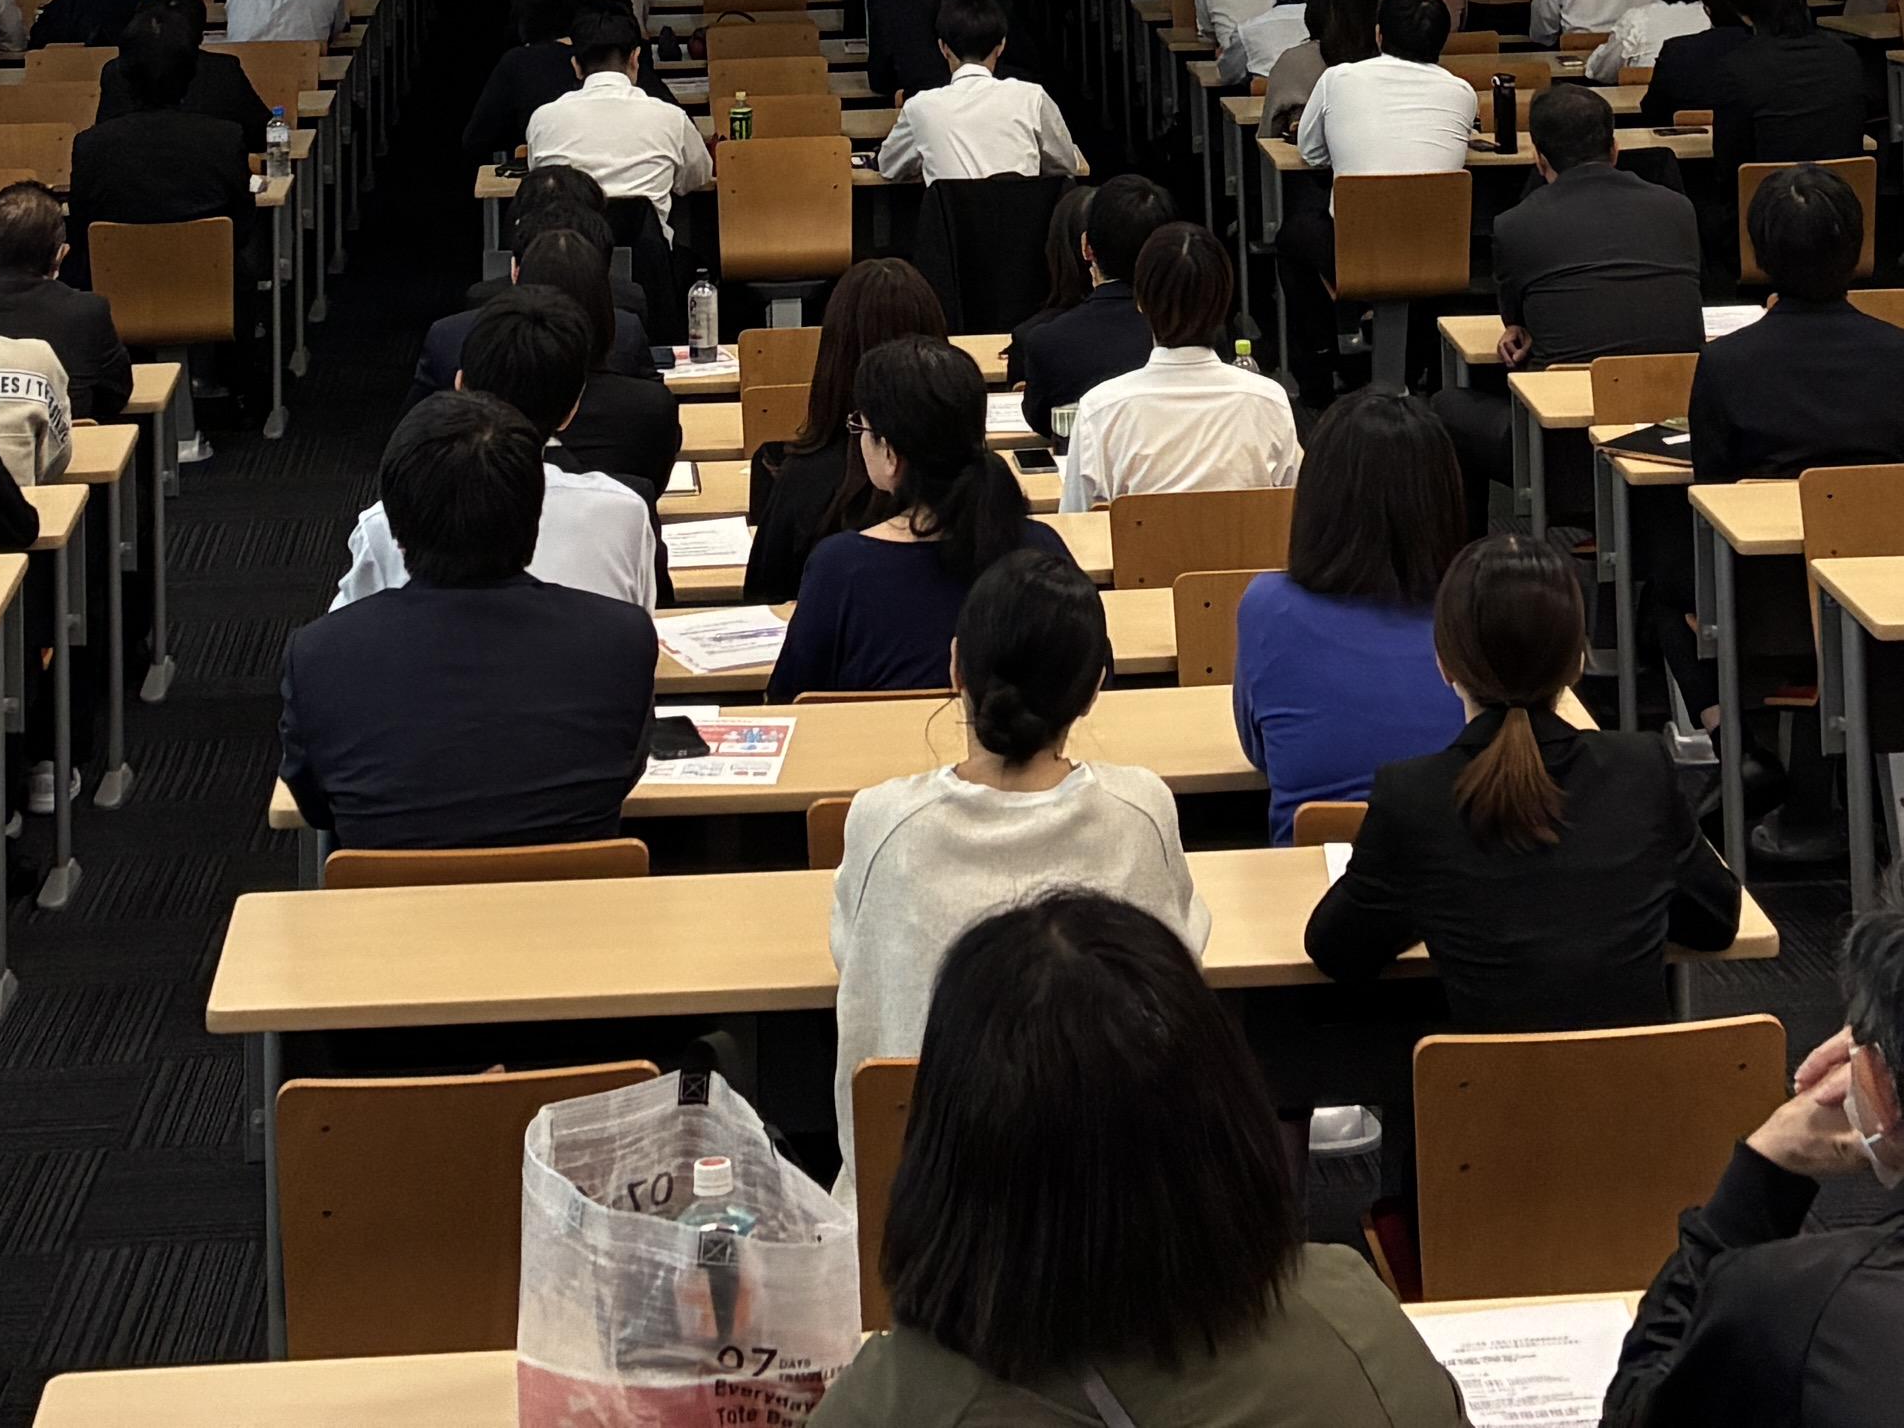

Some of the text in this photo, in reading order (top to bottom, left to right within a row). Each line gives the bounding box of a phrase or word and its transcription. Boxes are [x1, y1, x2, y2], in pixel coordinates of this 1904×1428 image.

[717, 1346, 778, 1376] 07
[717, 1405, 808, 1428] Tote Ba
